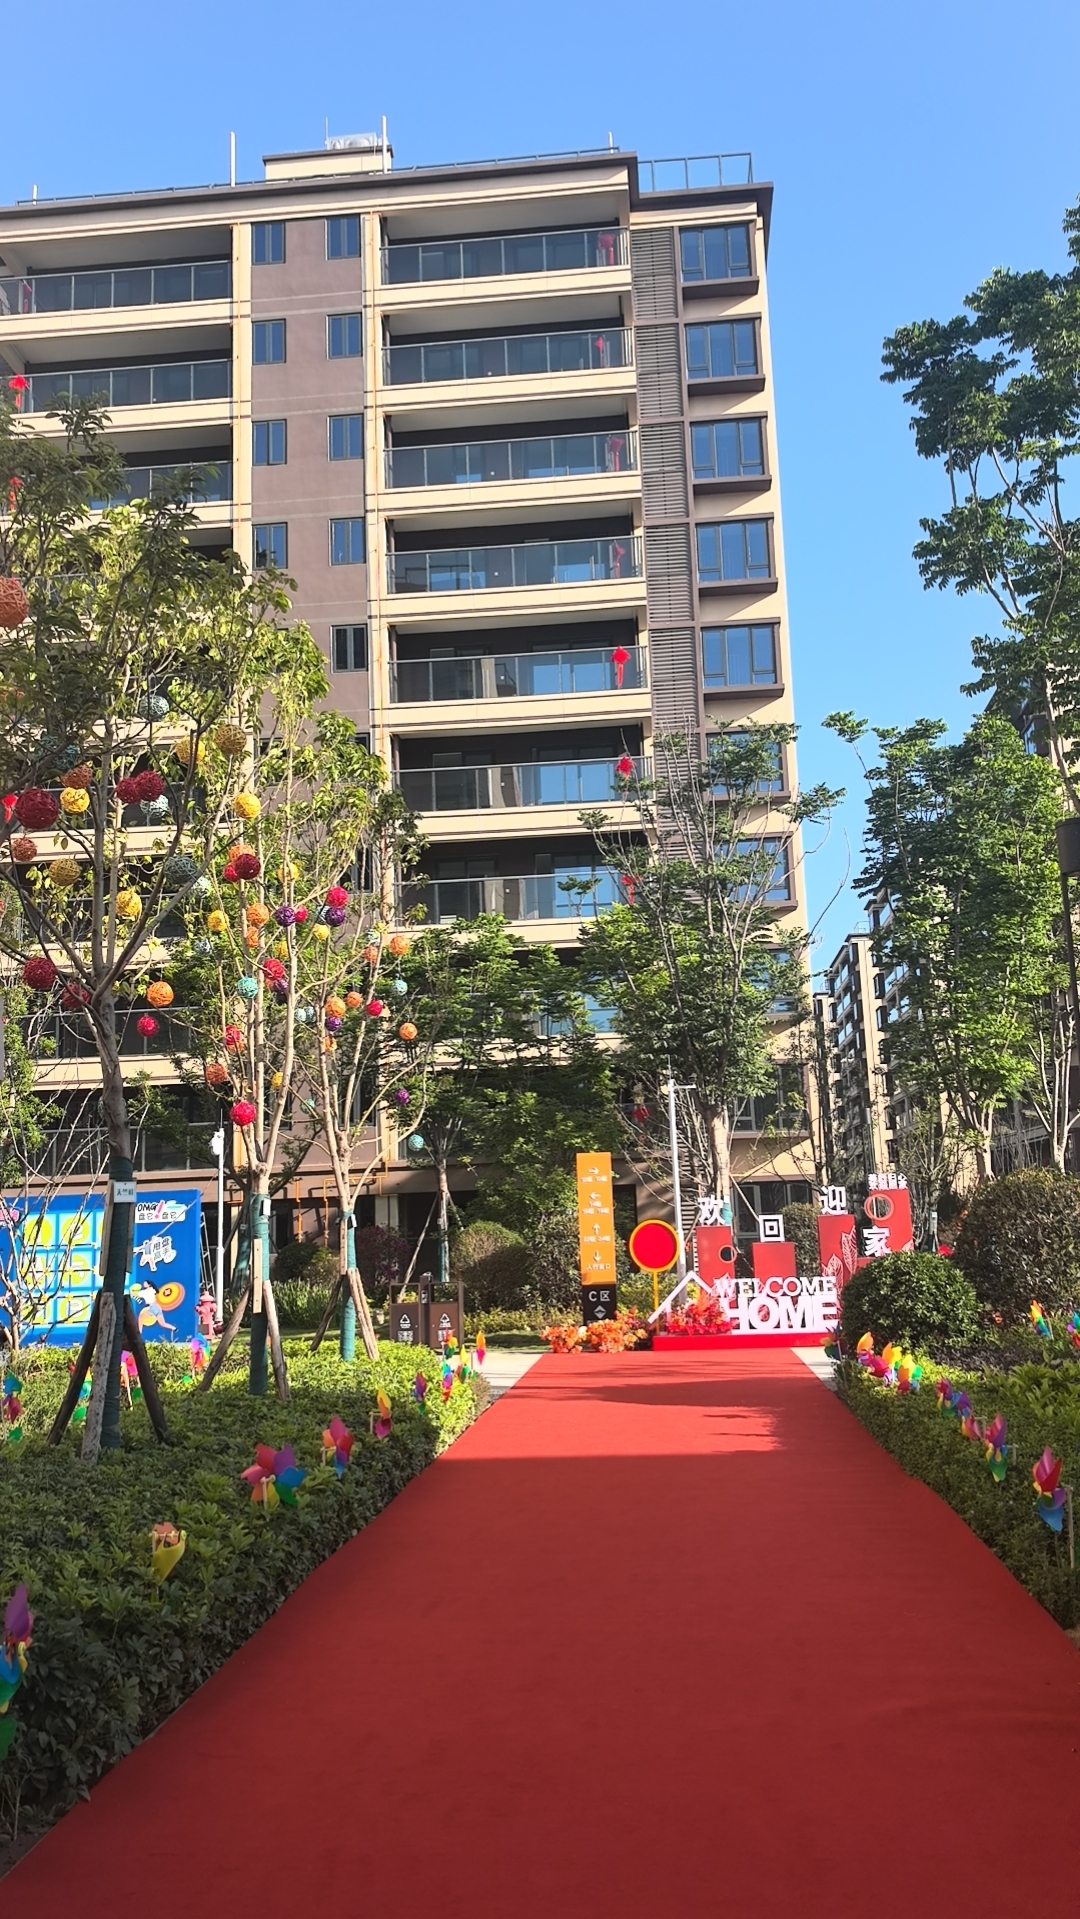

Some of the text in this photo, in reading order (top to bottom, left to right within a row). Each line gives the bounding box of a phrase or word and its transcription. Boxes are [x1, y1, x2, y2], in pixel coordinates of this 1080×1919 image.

[698, 1184, 849, 1226] 欢 迎
[759, 1214, 892, 1257] 回 家
[713, 1277, 837, 1298] WELCOME
[720, 1296, 839, 1332] HOME
